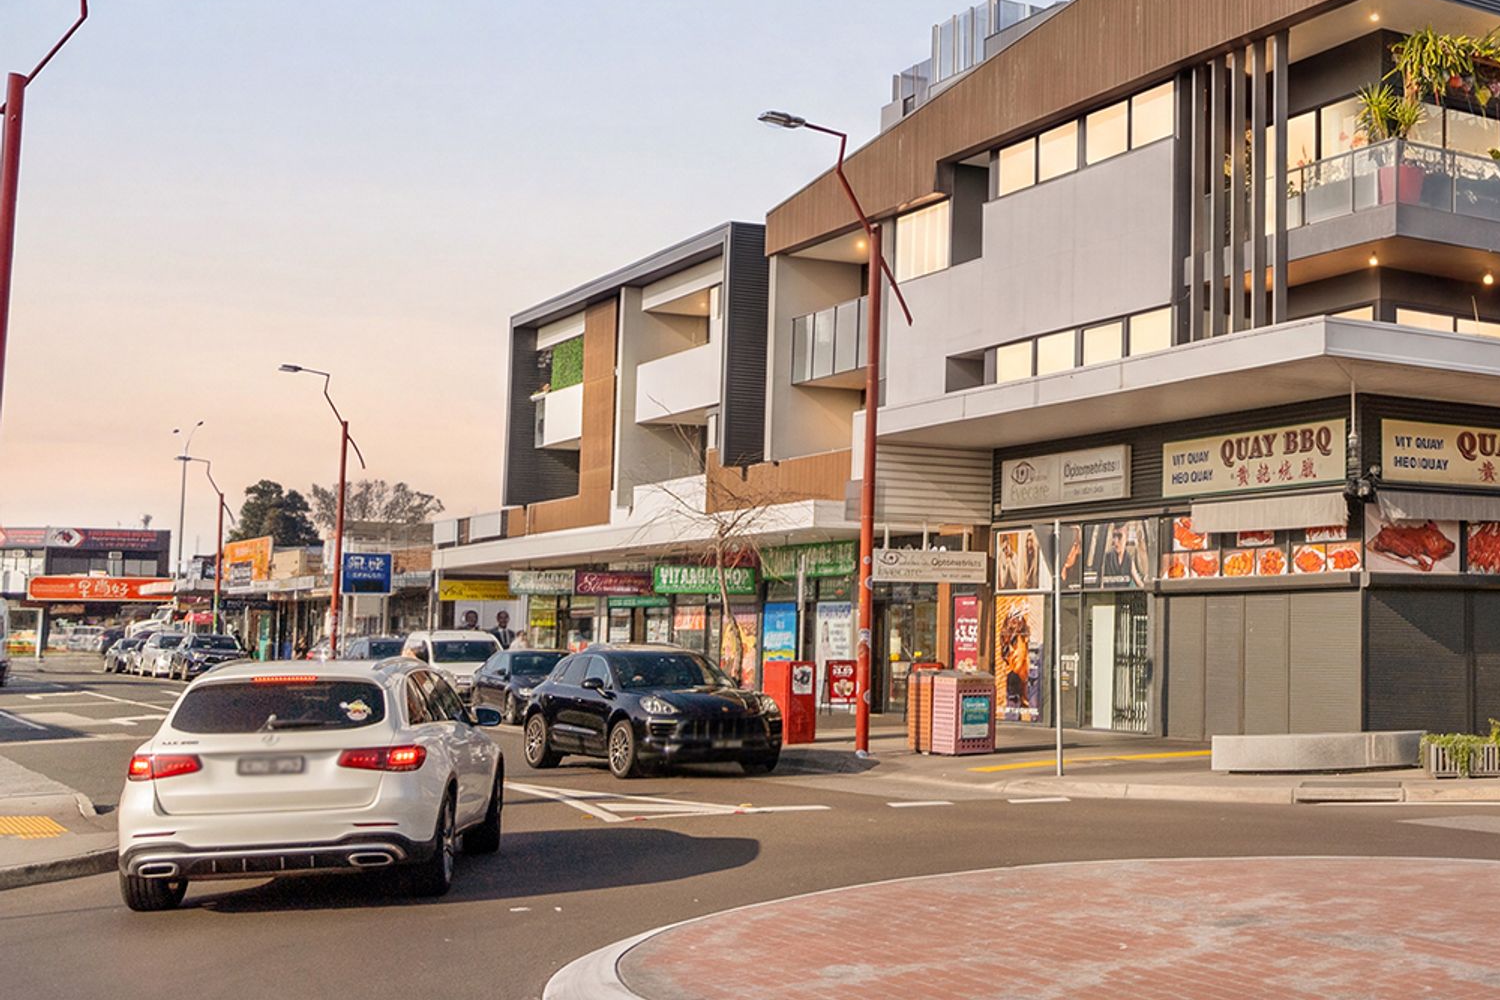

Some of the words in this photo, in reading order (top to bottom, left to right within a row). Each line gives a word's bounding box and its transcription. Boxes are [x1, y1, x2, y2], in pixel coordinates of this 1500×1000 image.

[1220, 433, 1277, 467] QUAY
[1283, 425, 1333, 456] BBQ
[1415, 437, 1444, 450] QUAY
[1187, 451, 1210, 464] QUAY
[1394, 456, 1417, 469] HEO
[1420, 458, 1449, 470] QUAY
[1190, 470, 1213, 484] QUAY
